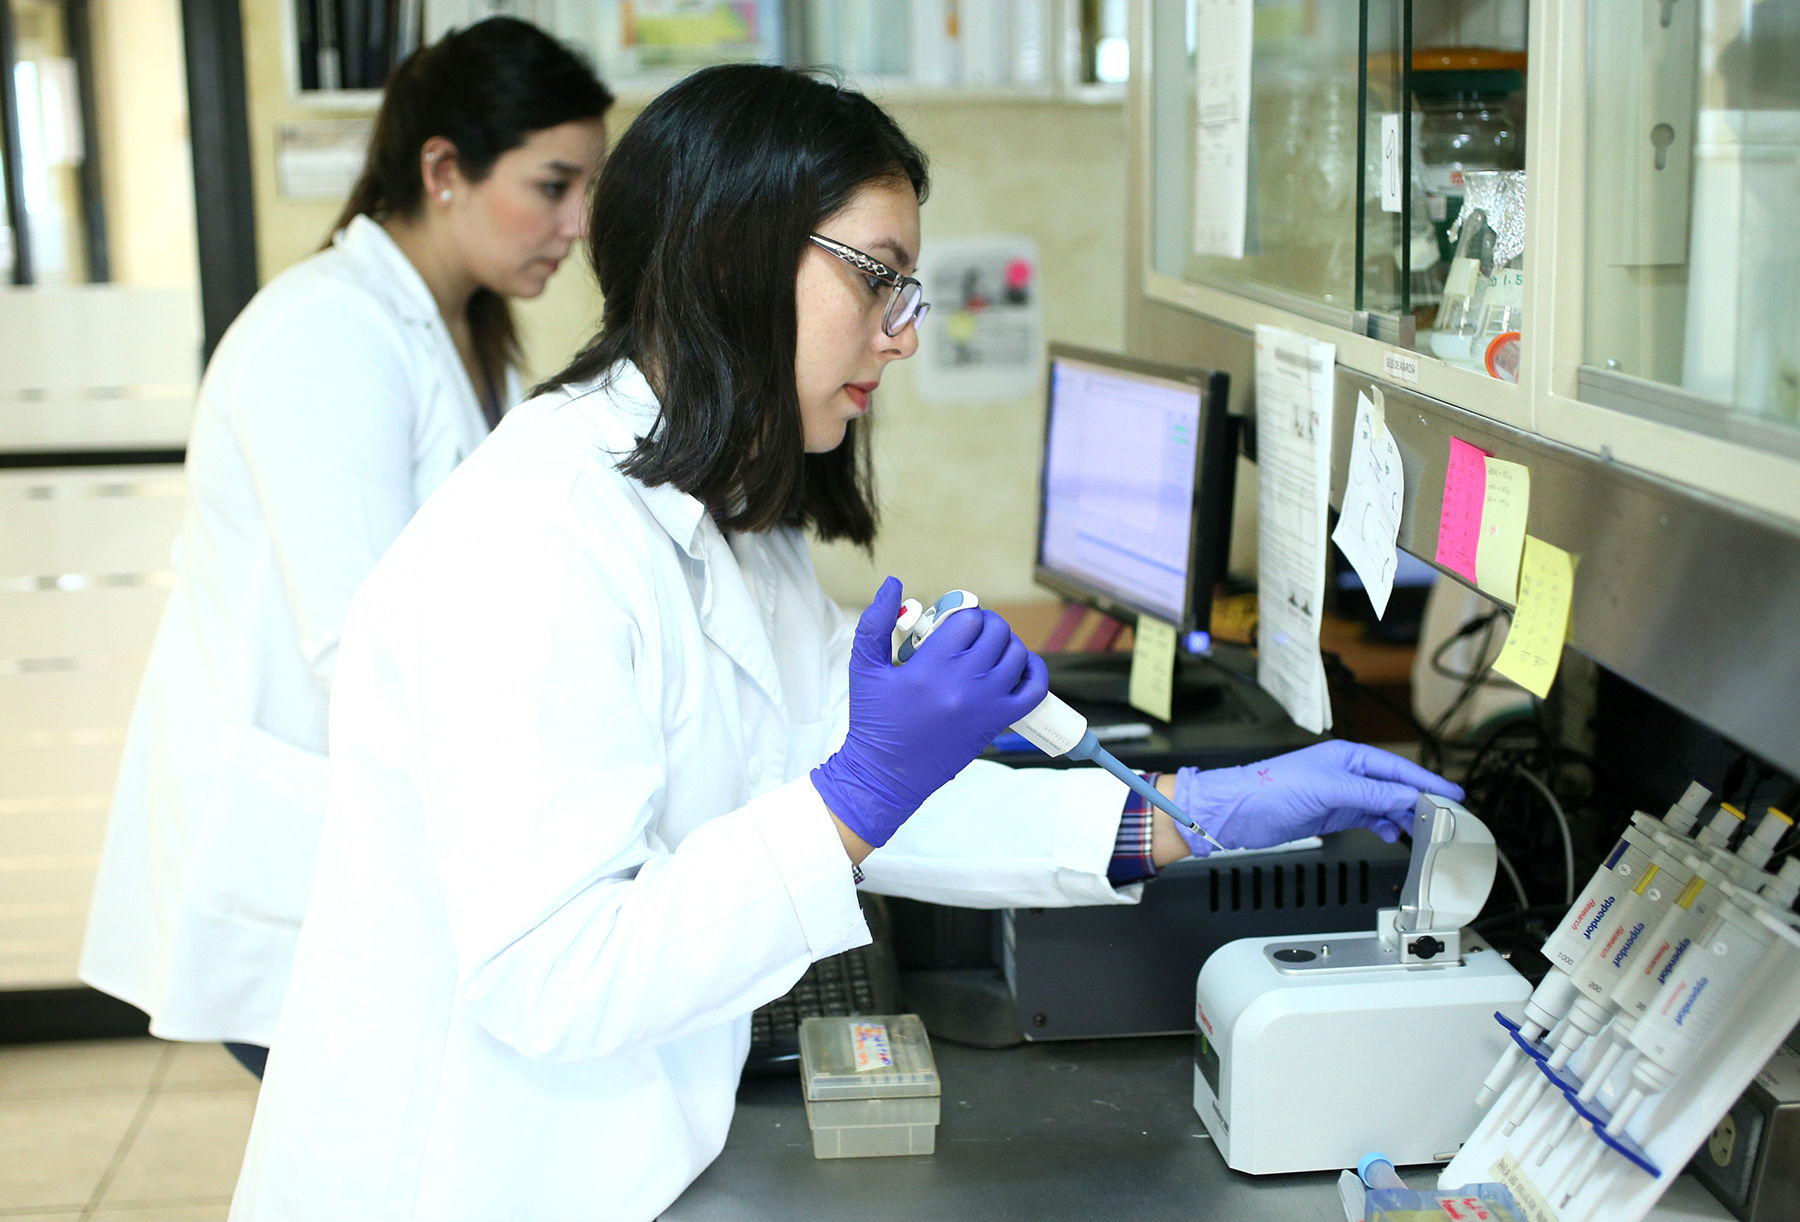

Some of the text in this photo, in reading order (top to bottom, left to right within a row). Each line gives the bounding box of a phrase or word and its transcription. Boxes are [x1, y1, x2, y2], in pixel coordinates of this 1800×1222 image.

[1571, 898, 1597, 931] Research
[1583, 895, 1616, 940] eppendorf
[1558, 952, 1574, 966] 1000
[1612, 922, 1645, 968] eppendorf
[1657, 938, 1691, 985] eppendorf
[1675, 977, 1708, 1026] eppendorf
